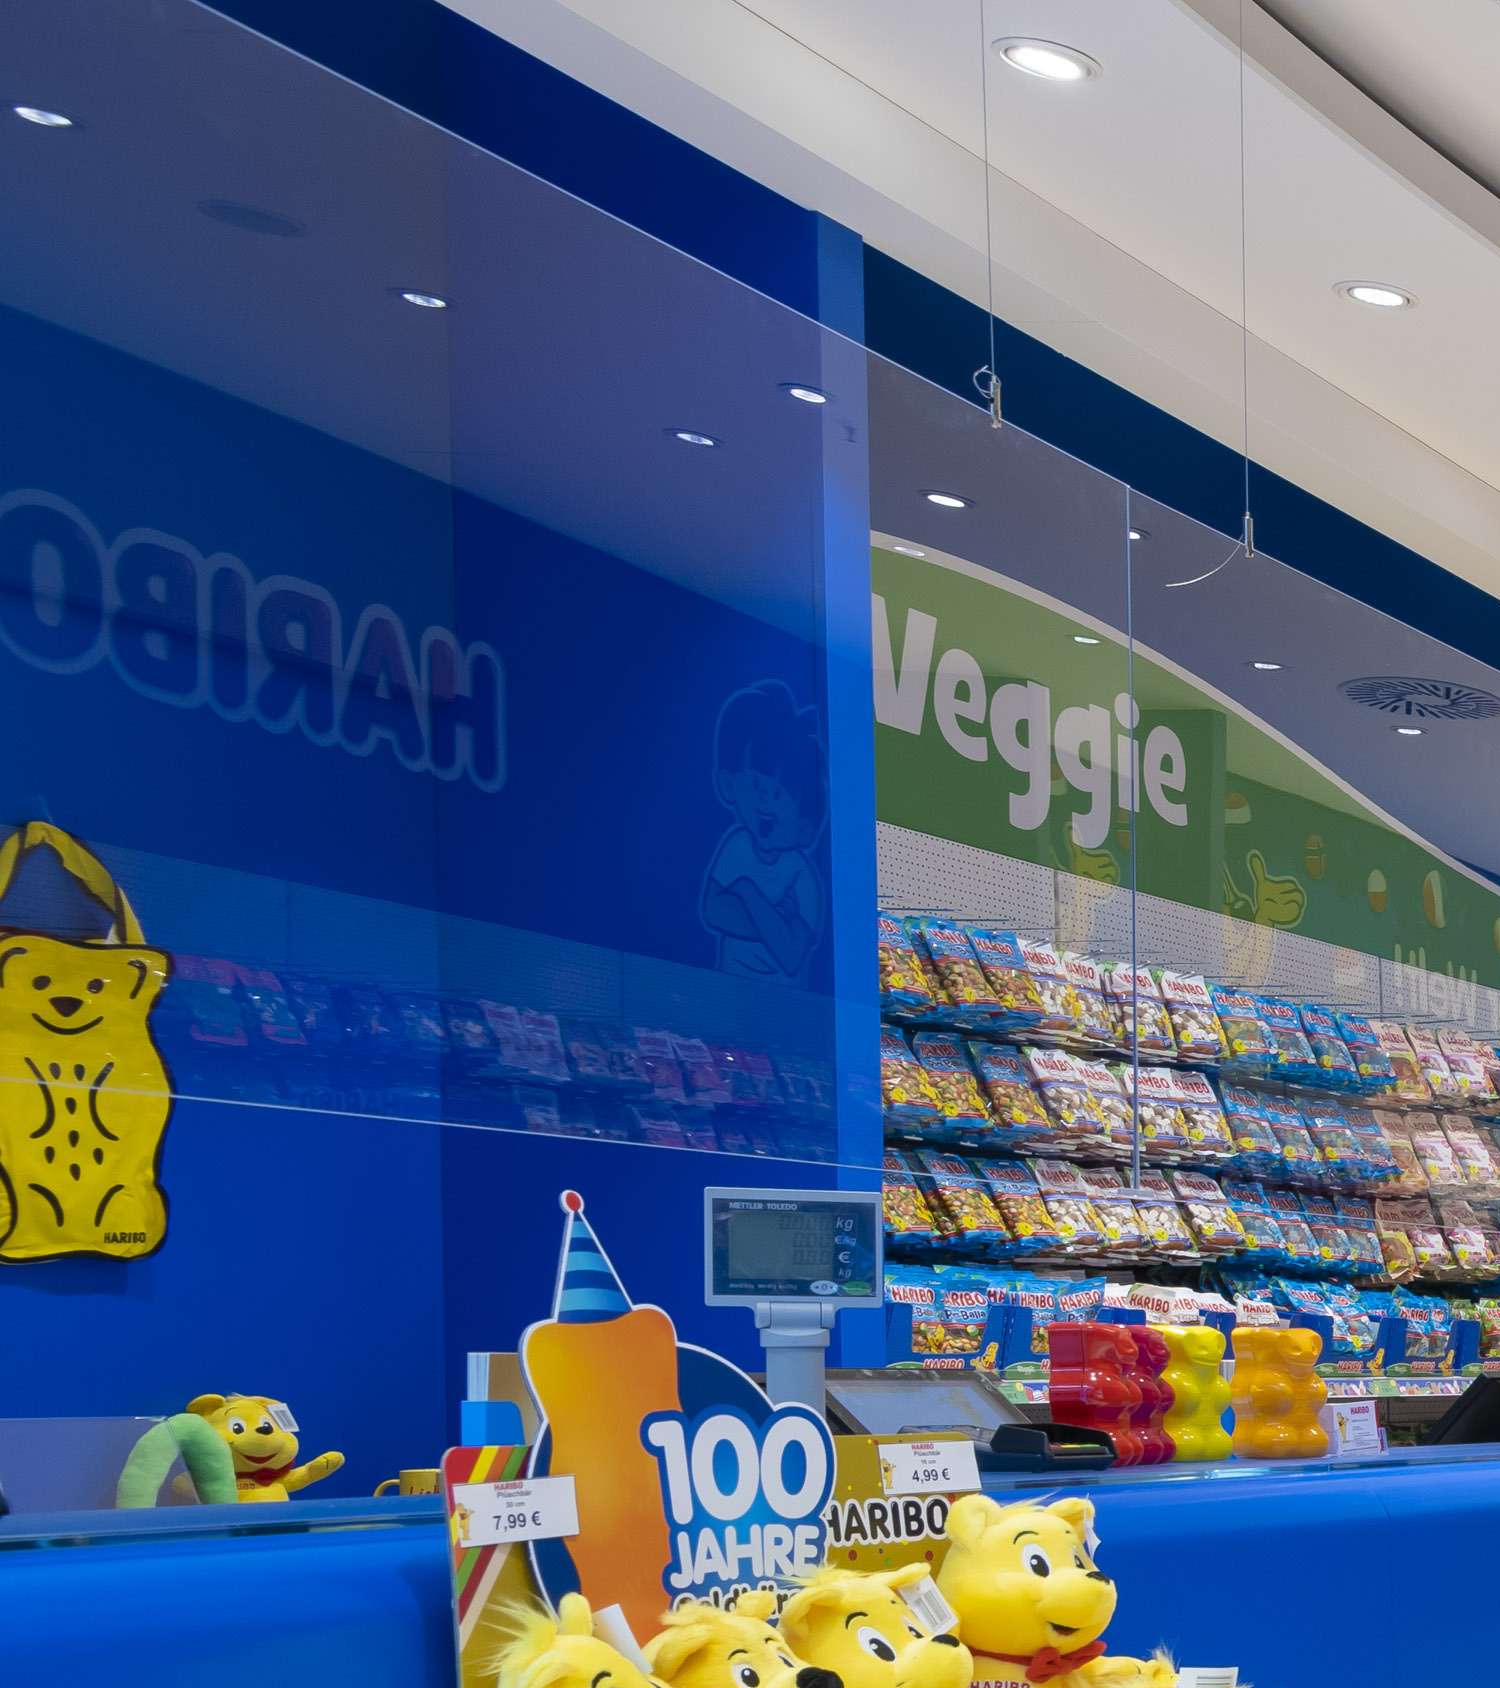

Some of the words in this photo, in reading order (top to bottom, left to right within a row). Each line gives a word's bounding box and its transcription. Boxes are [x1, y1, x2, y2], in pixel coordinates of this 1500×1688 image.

[872, 592, 1187, 848] Veggie
[729, 1202, 763, 1210] METTLER
[836, 1217, 853, 1231] kg
[839, 1252, 850, 1263] €
[839, 1269, 852, 1277] kg
[892, 1288, 935, 1303] HARIBO
[1130, 1295, 1170, 1313] HARIBO
[648, 1414, 827, 1525] 100
[912, 1469, 938, 1483] 4,99
[942, 1468, 950, 1481] €
[493, 1513, 526, 1532] 7,99
[532, 1511, 542, 1526] €
[823, 1498, 948, 1543] HARIBO
[670, 1524, 819, 1588] JAHRE
